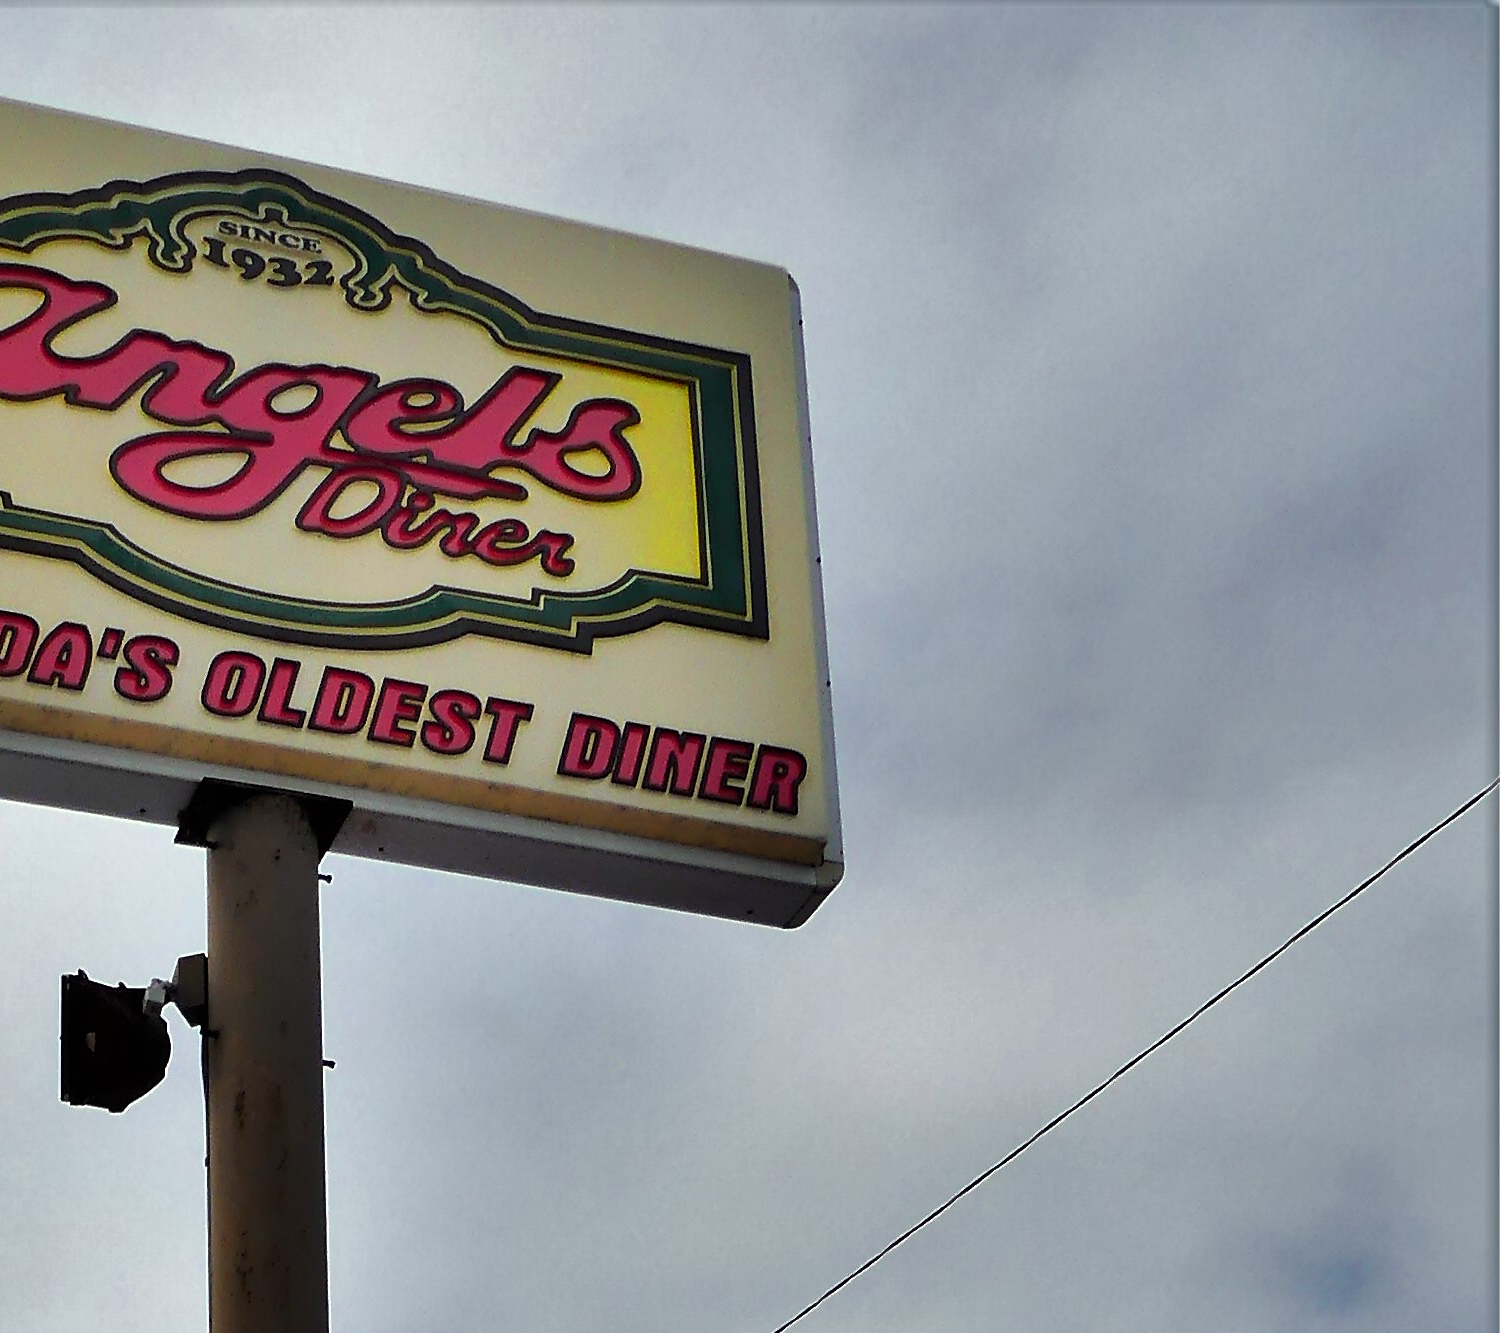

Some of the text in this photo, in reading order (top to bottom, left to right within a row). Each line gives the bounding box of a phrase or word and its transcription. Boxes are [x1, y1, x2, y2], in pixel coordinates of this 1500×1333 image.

[202, 236, 335, 287] 1932
[218, 221, 322, 254] SINCE
[295, 457, 575, 578] Diner
[201, 649, 535, 766] OLDEST
[556, 713, 809, 817] DINER
